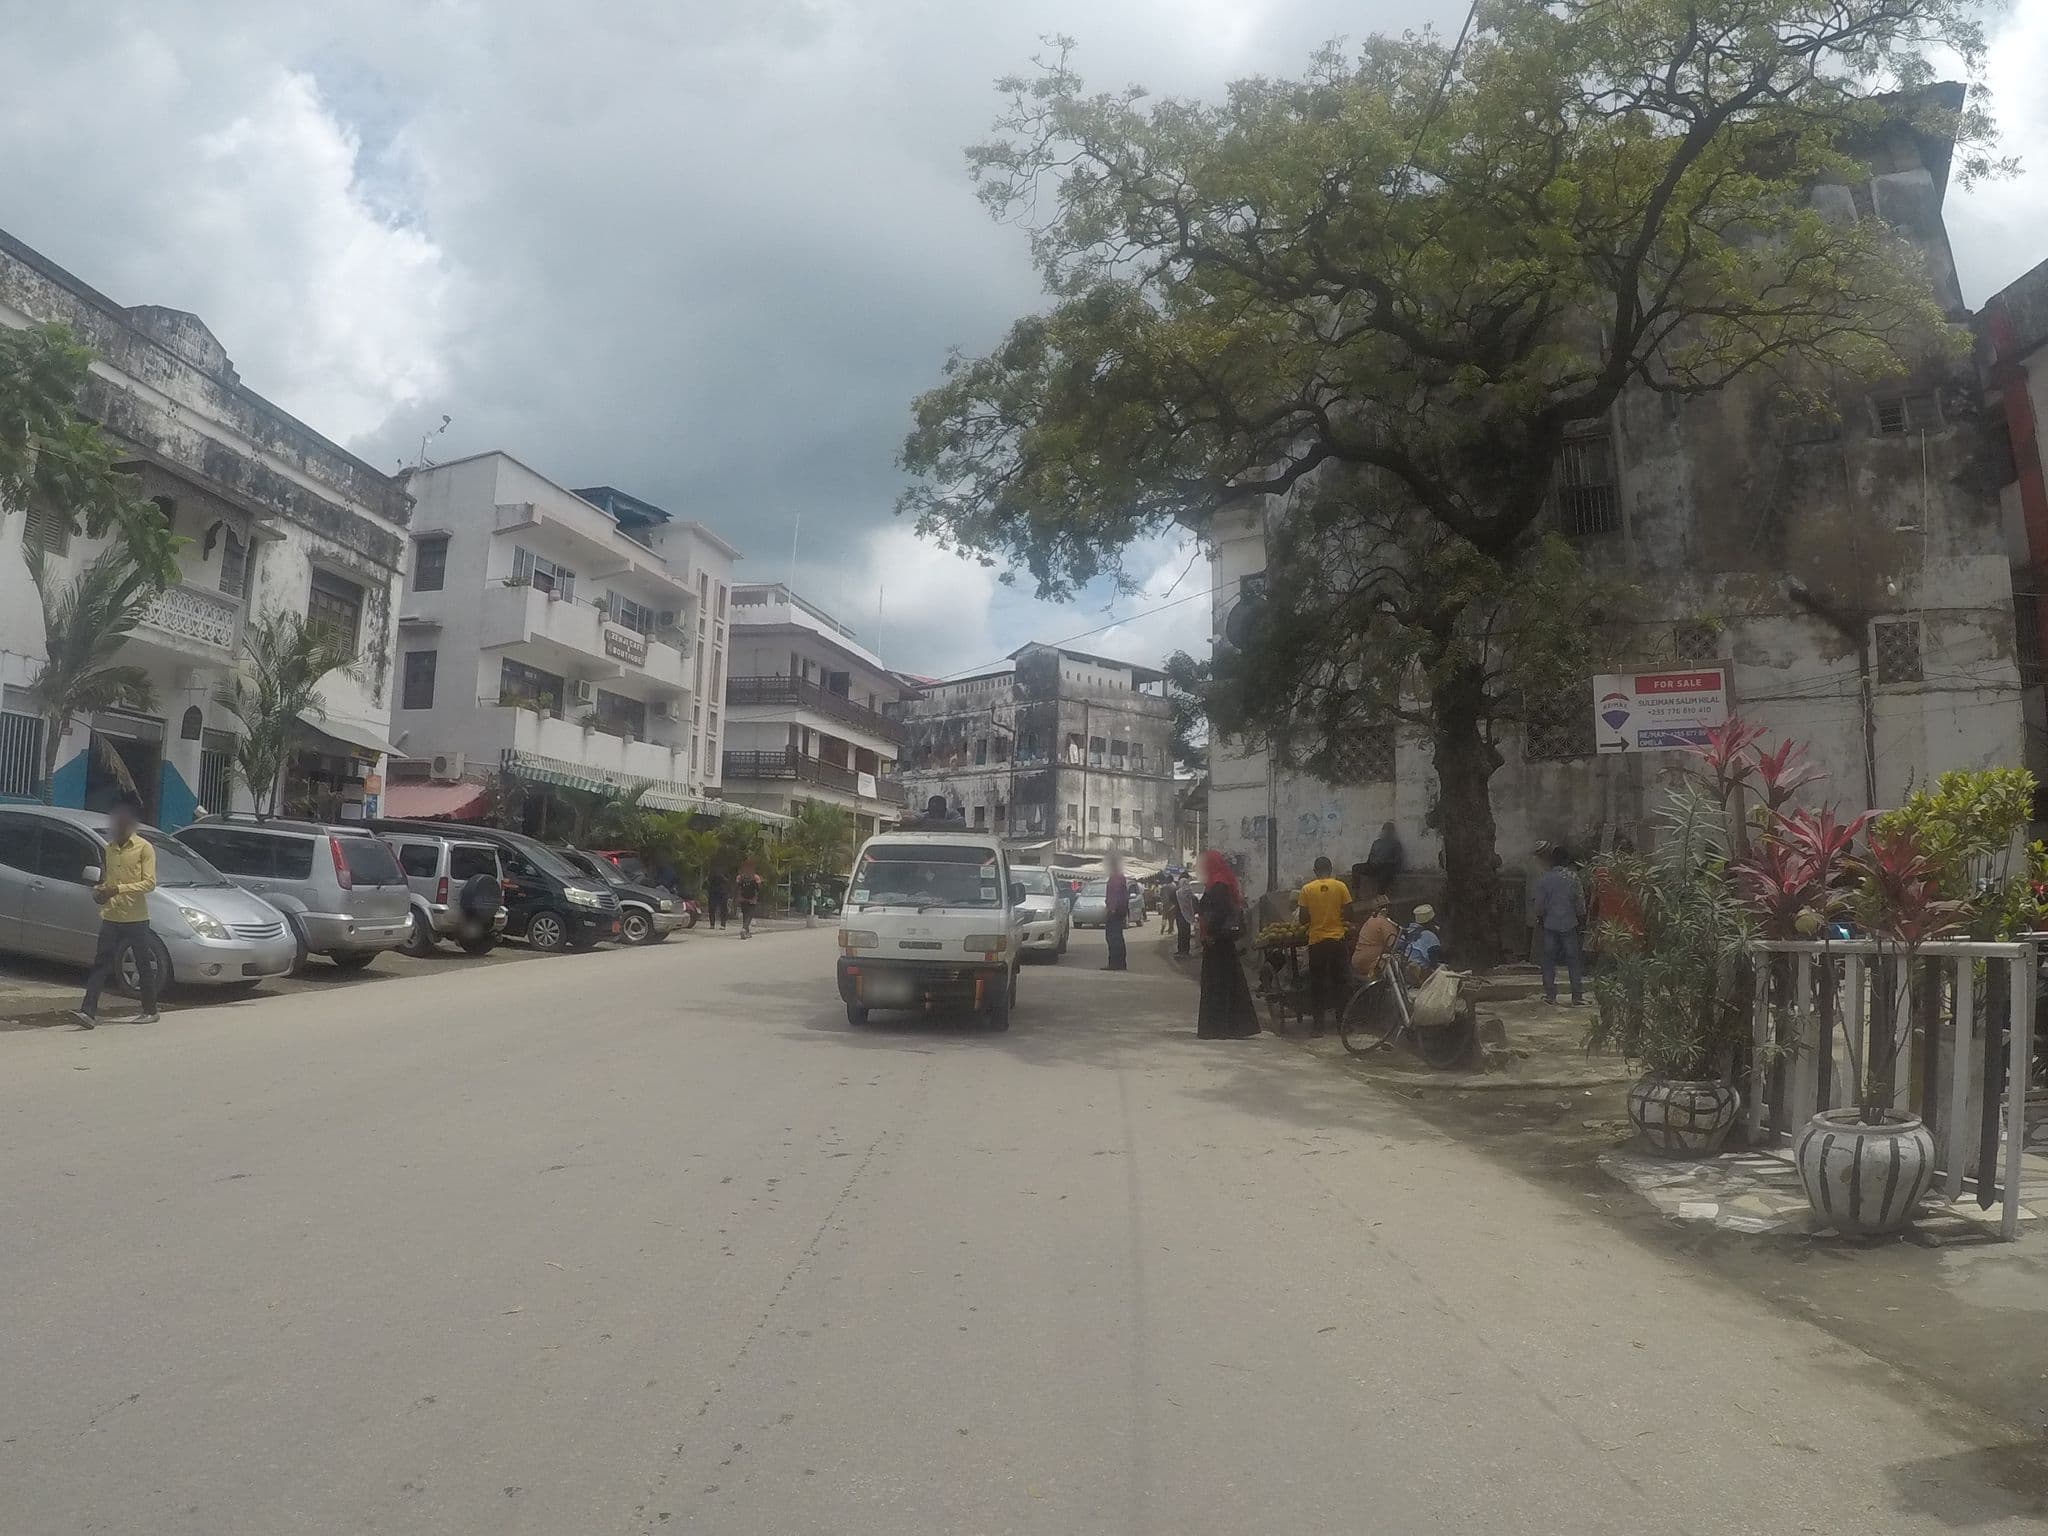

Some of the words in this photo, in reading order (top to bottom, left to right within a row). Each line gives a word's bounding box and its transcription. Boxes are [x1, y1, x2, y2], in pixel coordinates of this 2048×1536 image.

[612, 647, 642, 664] BOUTIQUE
[1654, 680, 1674, 689] FOR
[1677, 679, 1703, 688] SALE
